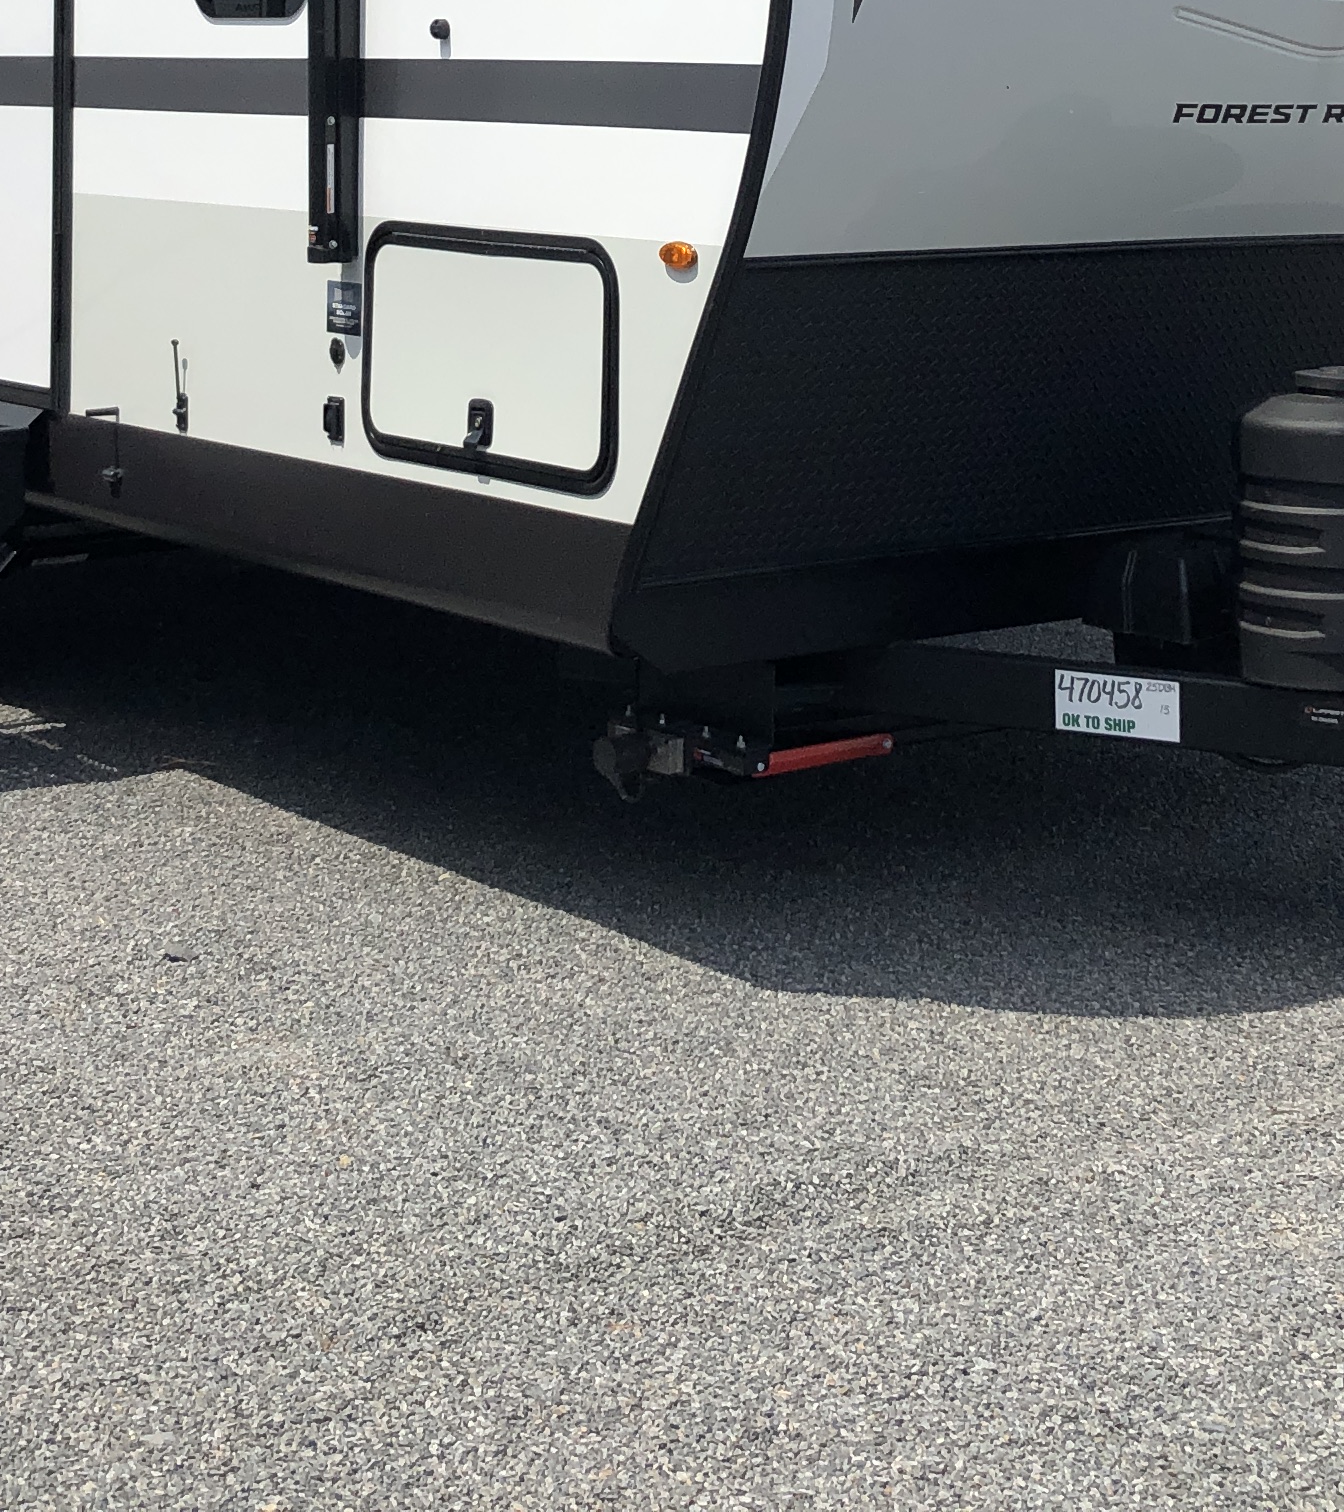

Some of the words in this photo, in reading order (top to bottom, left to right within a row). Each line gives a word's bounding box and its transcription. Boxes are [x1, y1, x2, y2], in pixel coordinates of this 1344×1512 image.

[1172, 103, 1317, 124] FOREST
[1058, 673, 1142, 709] 470458
[1062, 712, 1080, 728] OK
[1084, 715, 1100, 730] TO
[1105, 717, 1136, 733] SHIP
